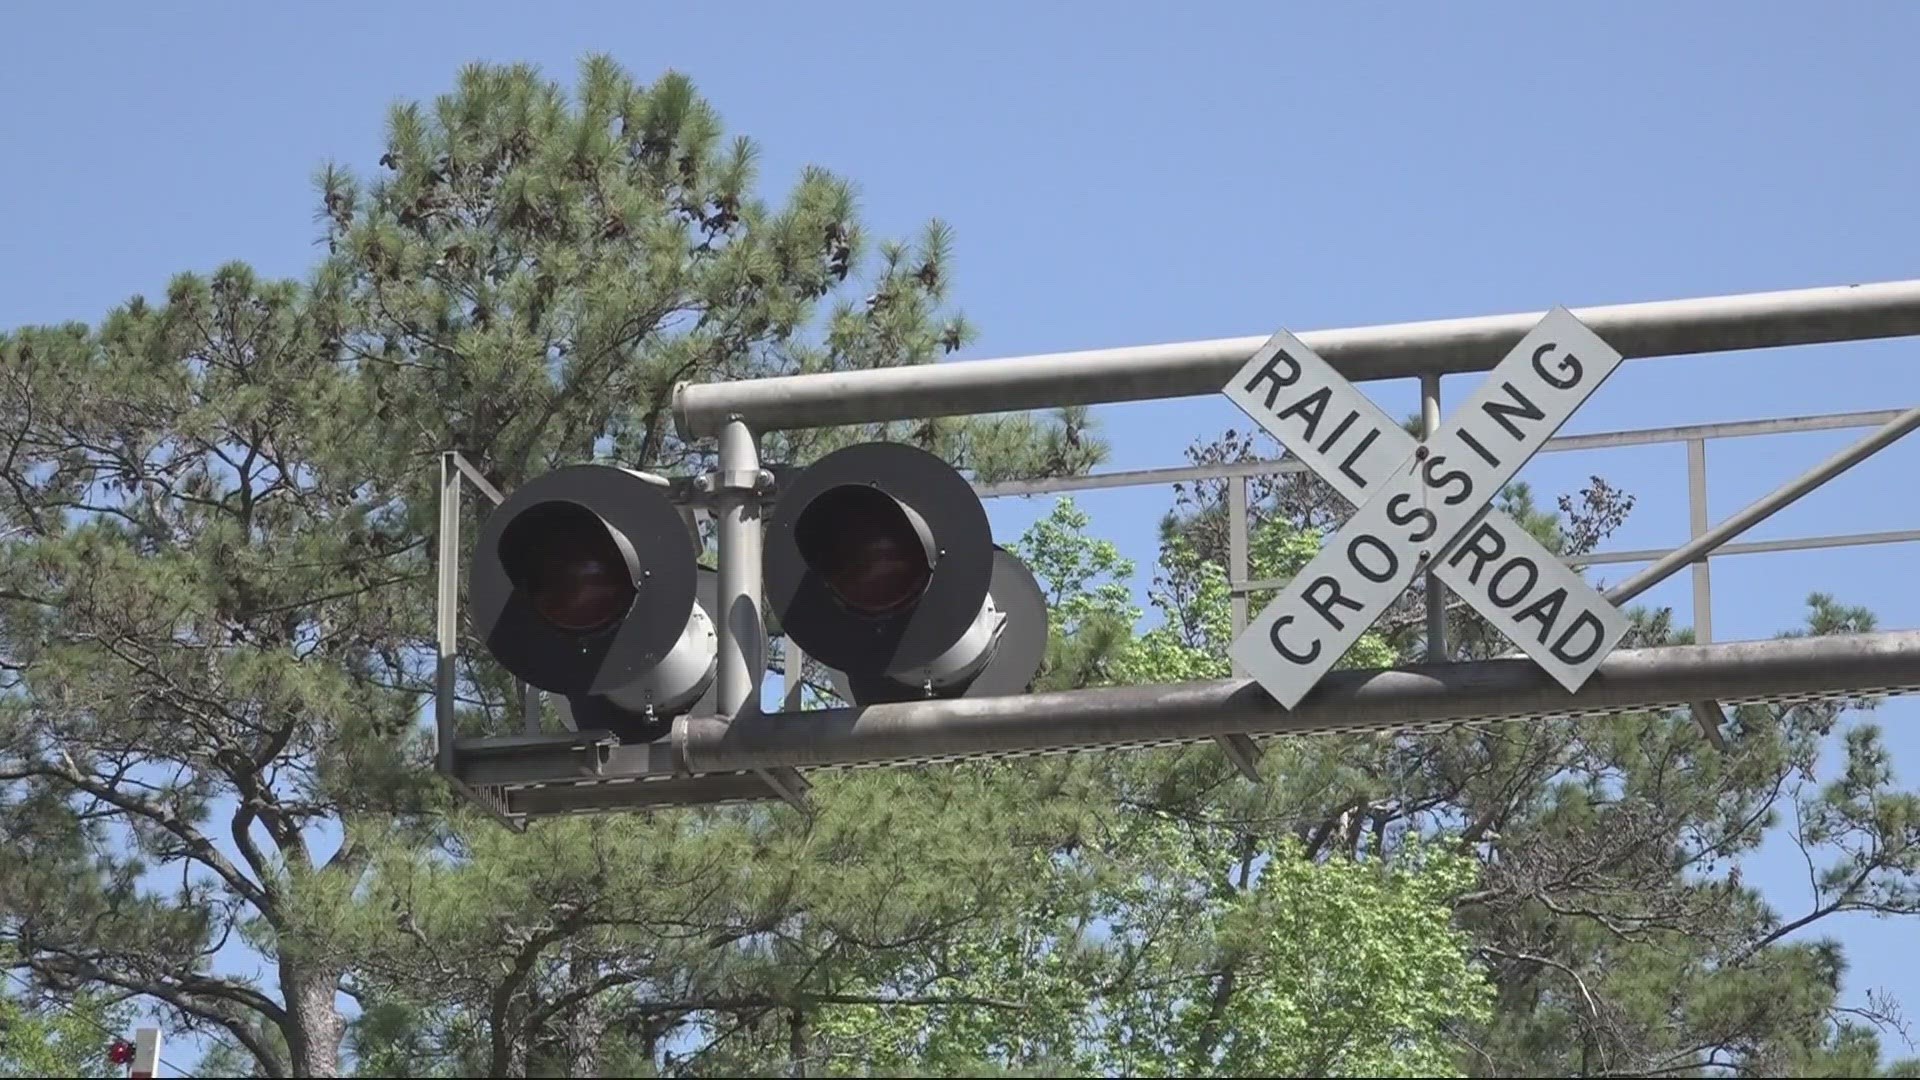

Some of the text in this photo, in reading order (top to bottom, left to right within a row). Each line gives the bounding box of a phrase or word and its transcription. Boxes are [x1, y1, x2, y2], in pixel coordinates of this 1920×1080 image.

[1244, 348, 1606, 666] RAIL ROAD
[1269, 342, 1584, 666] CROSSING
